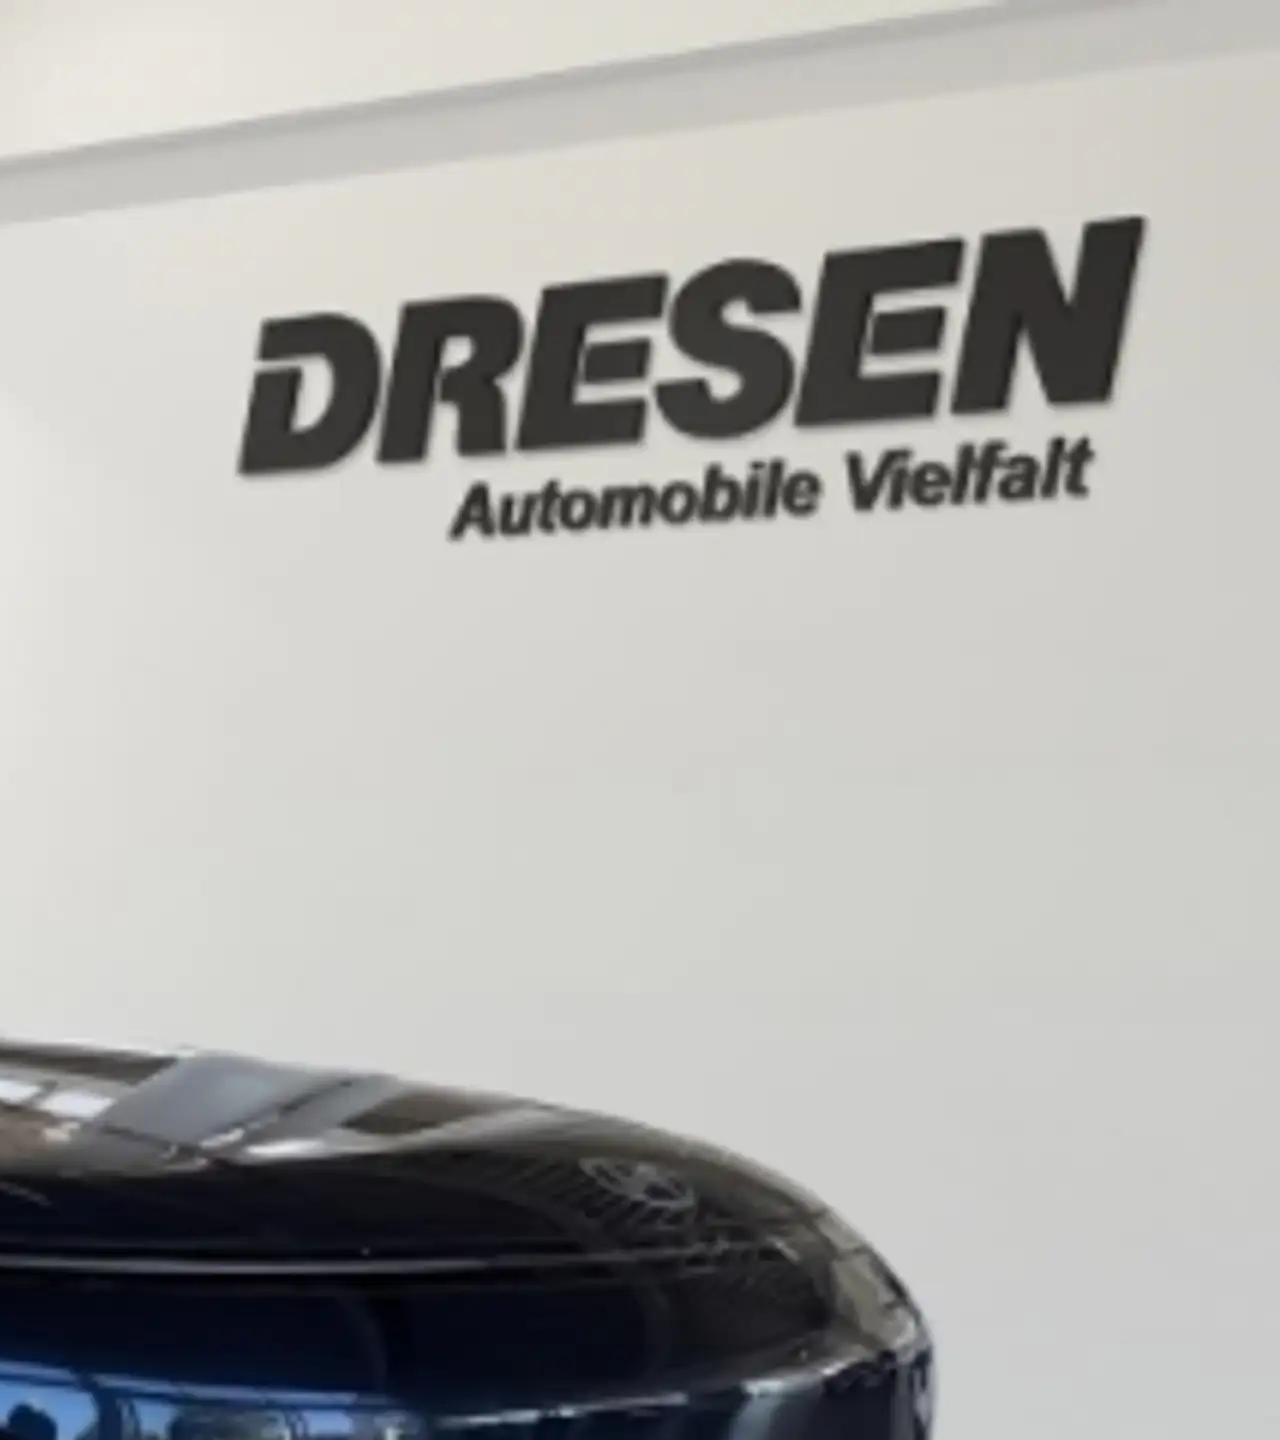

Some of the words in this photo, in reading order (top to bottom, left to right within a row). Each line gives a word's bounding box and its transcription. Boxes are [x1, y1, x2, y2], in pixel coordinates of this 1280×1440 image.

[239, 216, 1146, 476] DRESEN
[449, 459, 822, 541] Automobile
[846, 436, 1095, 512] Vielfalt
